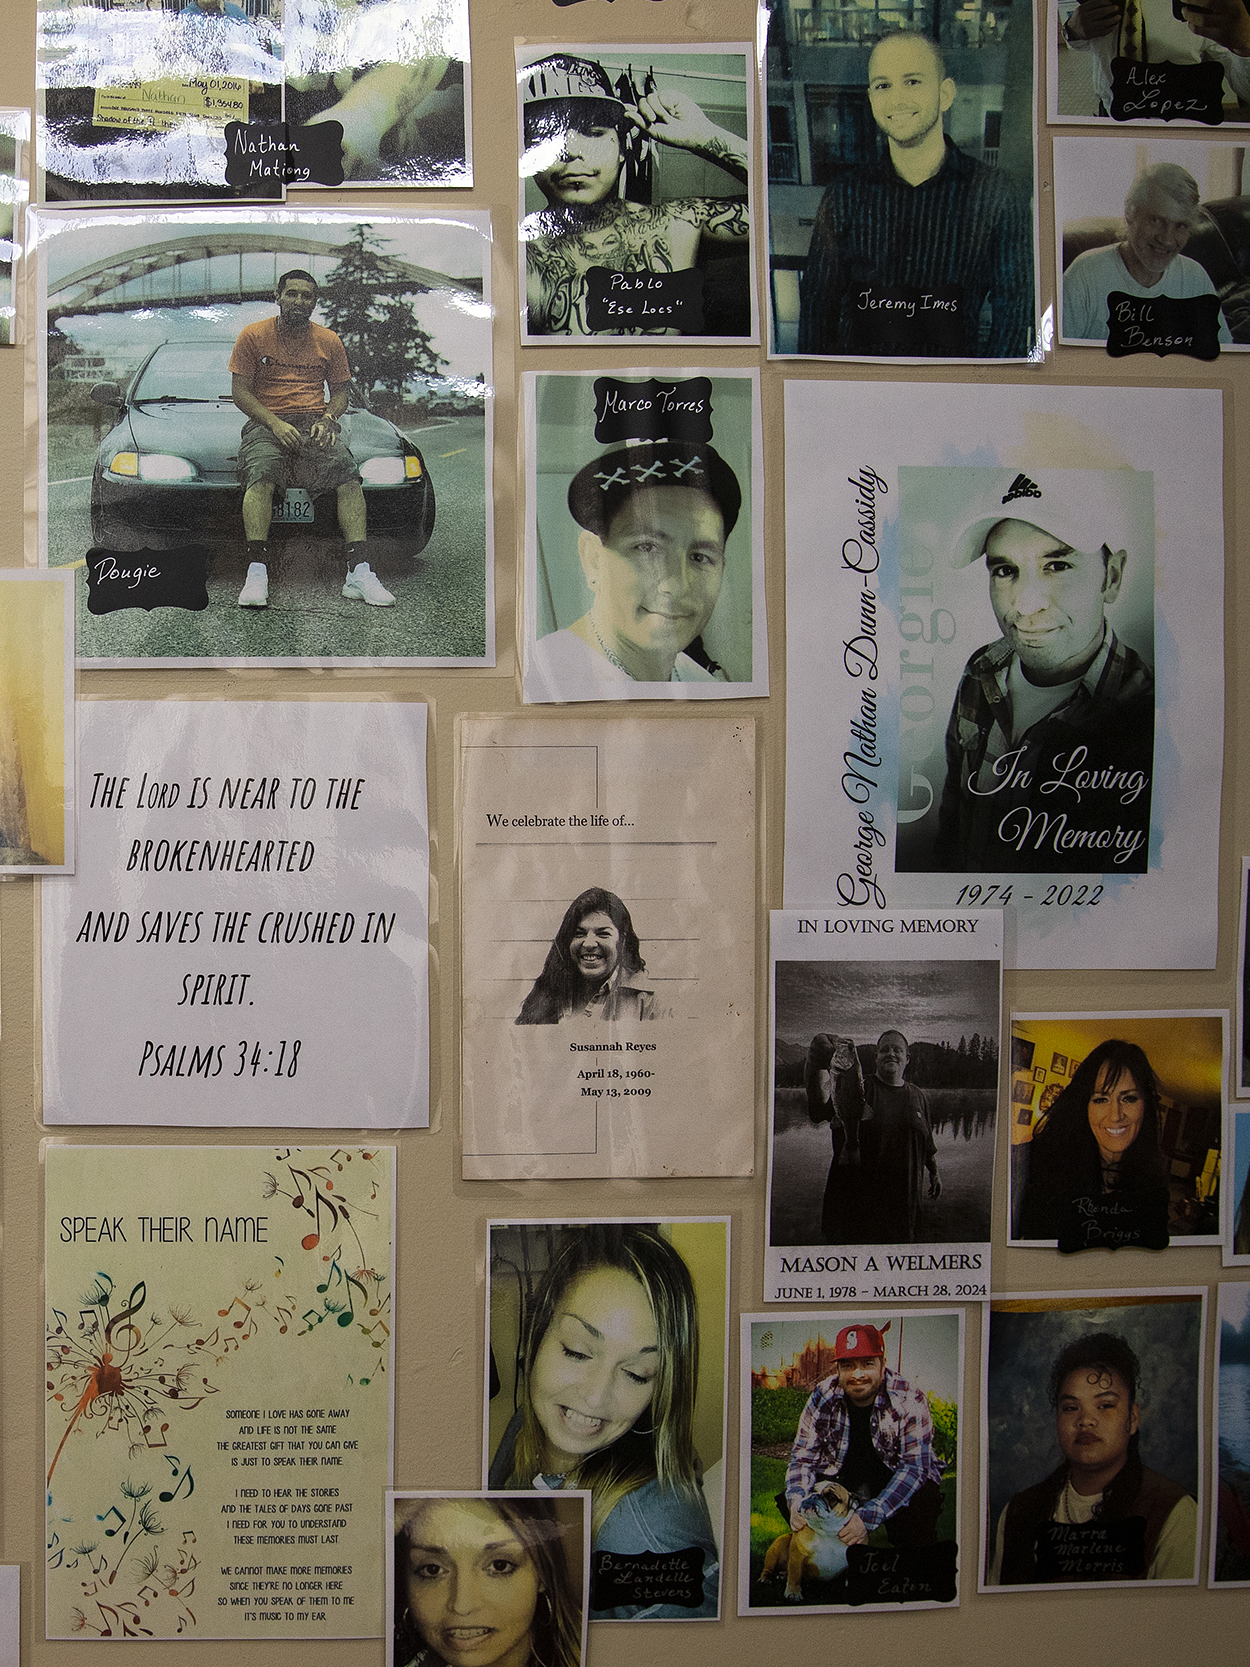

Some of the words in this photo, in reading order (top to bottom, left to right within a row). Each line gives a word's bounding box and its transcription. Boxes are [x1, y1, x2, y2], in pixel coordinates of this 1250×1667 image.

[1125, 67, 1167, 86] Alex
[1123, 89, 1208, 113] Lopez
[234, 128, 300, 156] Nathan
[610, 274, 662, 291] Pablo
[858, 288, 915, 318] Jeremy
[920, 295, 957, 313] Imes
[1116, 300, 1155, 323] Bill
[1120, 325, 1193, 348] Benson
[599, 391, 652, 423] Marco
[656, 387, 704, 414] Torres
[94, 557, 161, 589] Dougie
[841, 465, 889, 681] Dunn-Cassidy
[842, 688, 883, 804] Nathan
[967, 747, 1032, 796] In
[1039, 746, 1148, 805] Loving
[486, 814, 509, 827] We
[512, 814, 566, 827] celebrate
[568, 814, 588, 827] the
[590, 814, 609, 827] life
[998, 807, 1145, 864] Memory
[126, 839, 315, 872] BROKENHEARTED
[836, 813, 886, 909] George
[955, 884, 1013, 907] 1974
[1040, 884, 1105, 906] 2022
[76, 910, 130, 943] AND
[136, 910, 204, 943] SAVES
[211, 910, 252, 943] THE
[258, 910, 356, 943] CRUSHED
[797, 919, 817, 933] IN
[824, 919, 895, 933] LOVING
[900, 919, 979, 933] MEMORY
[234, 1040, 302, 1078] 34:18
[569, 1042, 623, 1052] Susannah
[625, 1042, 657, 1054] Reyes
[577, 1068, 605, 1080] April
[607, 1070, 622, 1080] 18,
[625, 1070, 655, 1080] 1960-
[581, 1087, 603, 1098] May
[606, 1088, 620, 1099] 13,
[623, 1088, 651, 1098] 2009
[1071, 1197, 1133, 1216] Rhonda
[60, 1217, 127, 1243] SPEAK
[139, 1217, 193, 1243] THEIR
[204, 1217, 268, 1242] NAME
[1081, 1219, 1141, 1243] Briggs
[780, 1256, 856, 1273] MASON
[863, 1256, 879, 1272] A
[886, 1254, 982, 1271] WELMERS
[774, 1287, 812, 1299] JUNE
[816, 1287, 826, 1299] 1,
[829, 1287, 856, 1298] 1978
[873, 1286, 929, 1298] MARCH
[932, 1285, 951, 1298] 28,
[955, 1284, 987, 1296] 2024
[217, 1442, 229, 1450] THE
[232, 1442, 266, 1450] GREATEST
[270, 1441, 284, 1450] GIFT
[288, 1441, 304, 1450] THAT
[309, 1441, 323, 1449] YOU
[343, 1440, 359, 1449] GIVE
[598, 1554, 690, 1575] Bernadette
[632, 1587, 692, 1599] Stevens
